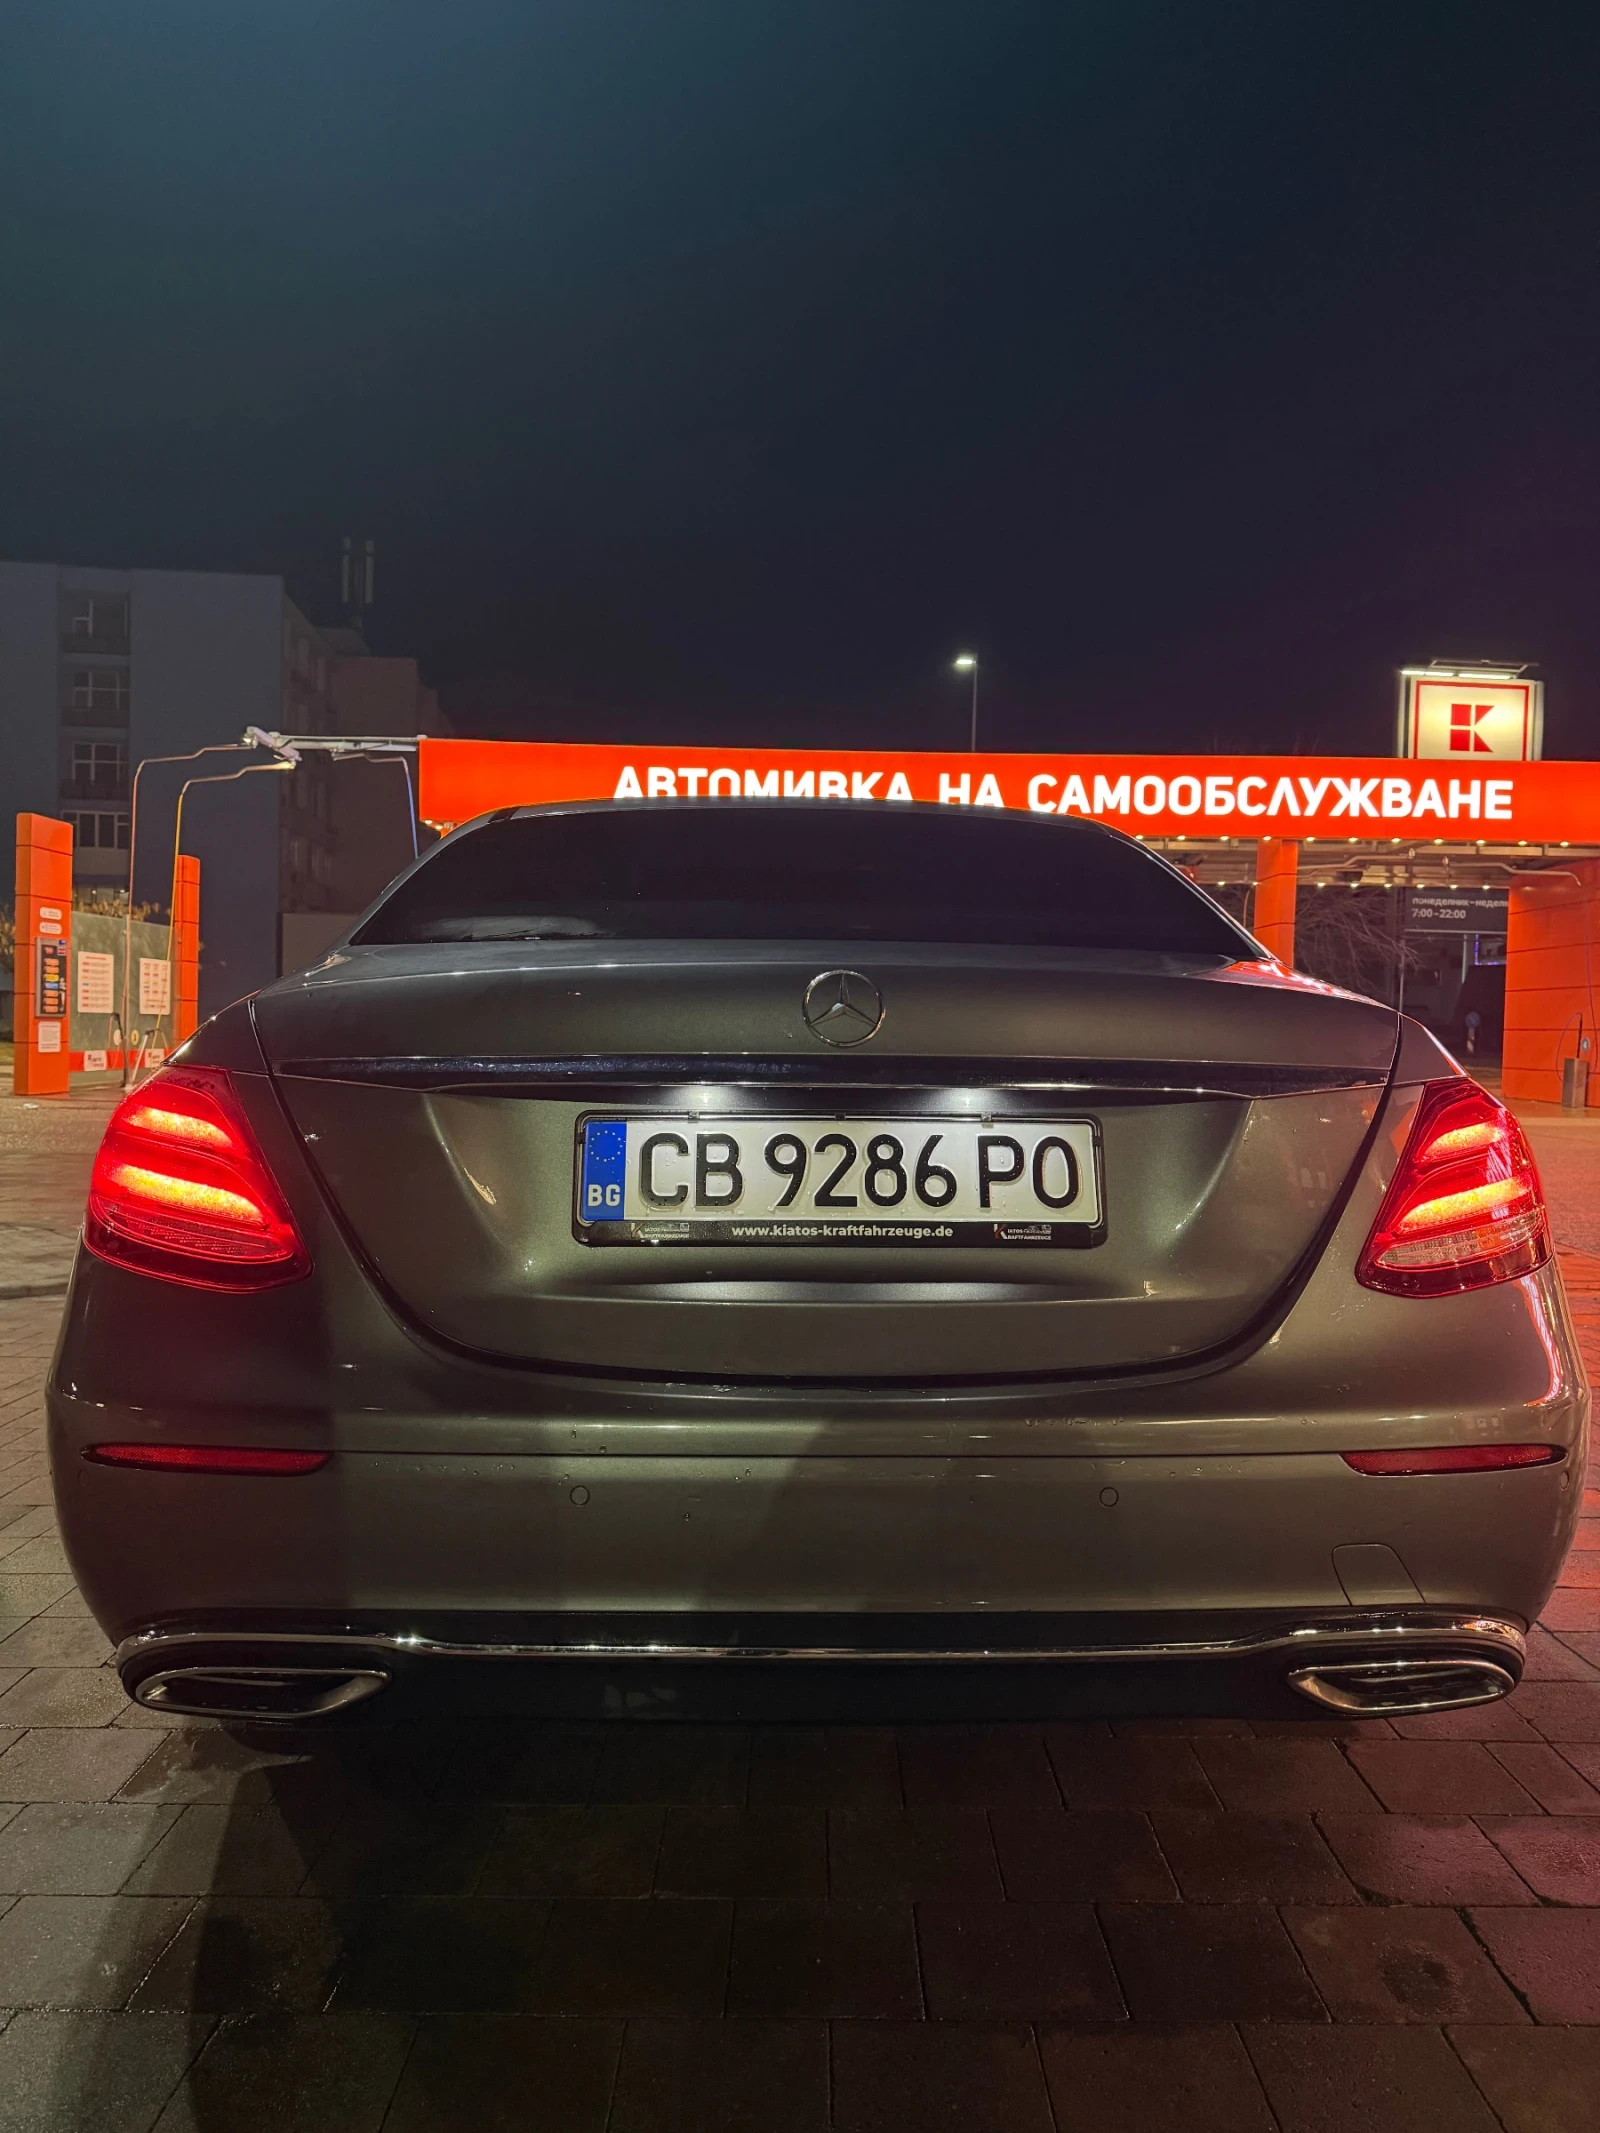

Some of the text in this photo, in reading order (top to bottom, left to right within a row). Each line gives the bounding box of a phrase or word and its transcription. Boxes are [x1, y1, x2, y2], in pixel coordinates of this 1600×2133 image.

[613, 766, 1514, 819] АВТОМИВКА НА САМООБСЛУЖВАНЕ
[640, 1132, 744, 1207] CB
[764, 1132, 958, 1208] 9286
[587, 1184, 621, 1207] BG
[732, 1225, 954, 1240] www.kiatos-kraftfahrzeuge.de
